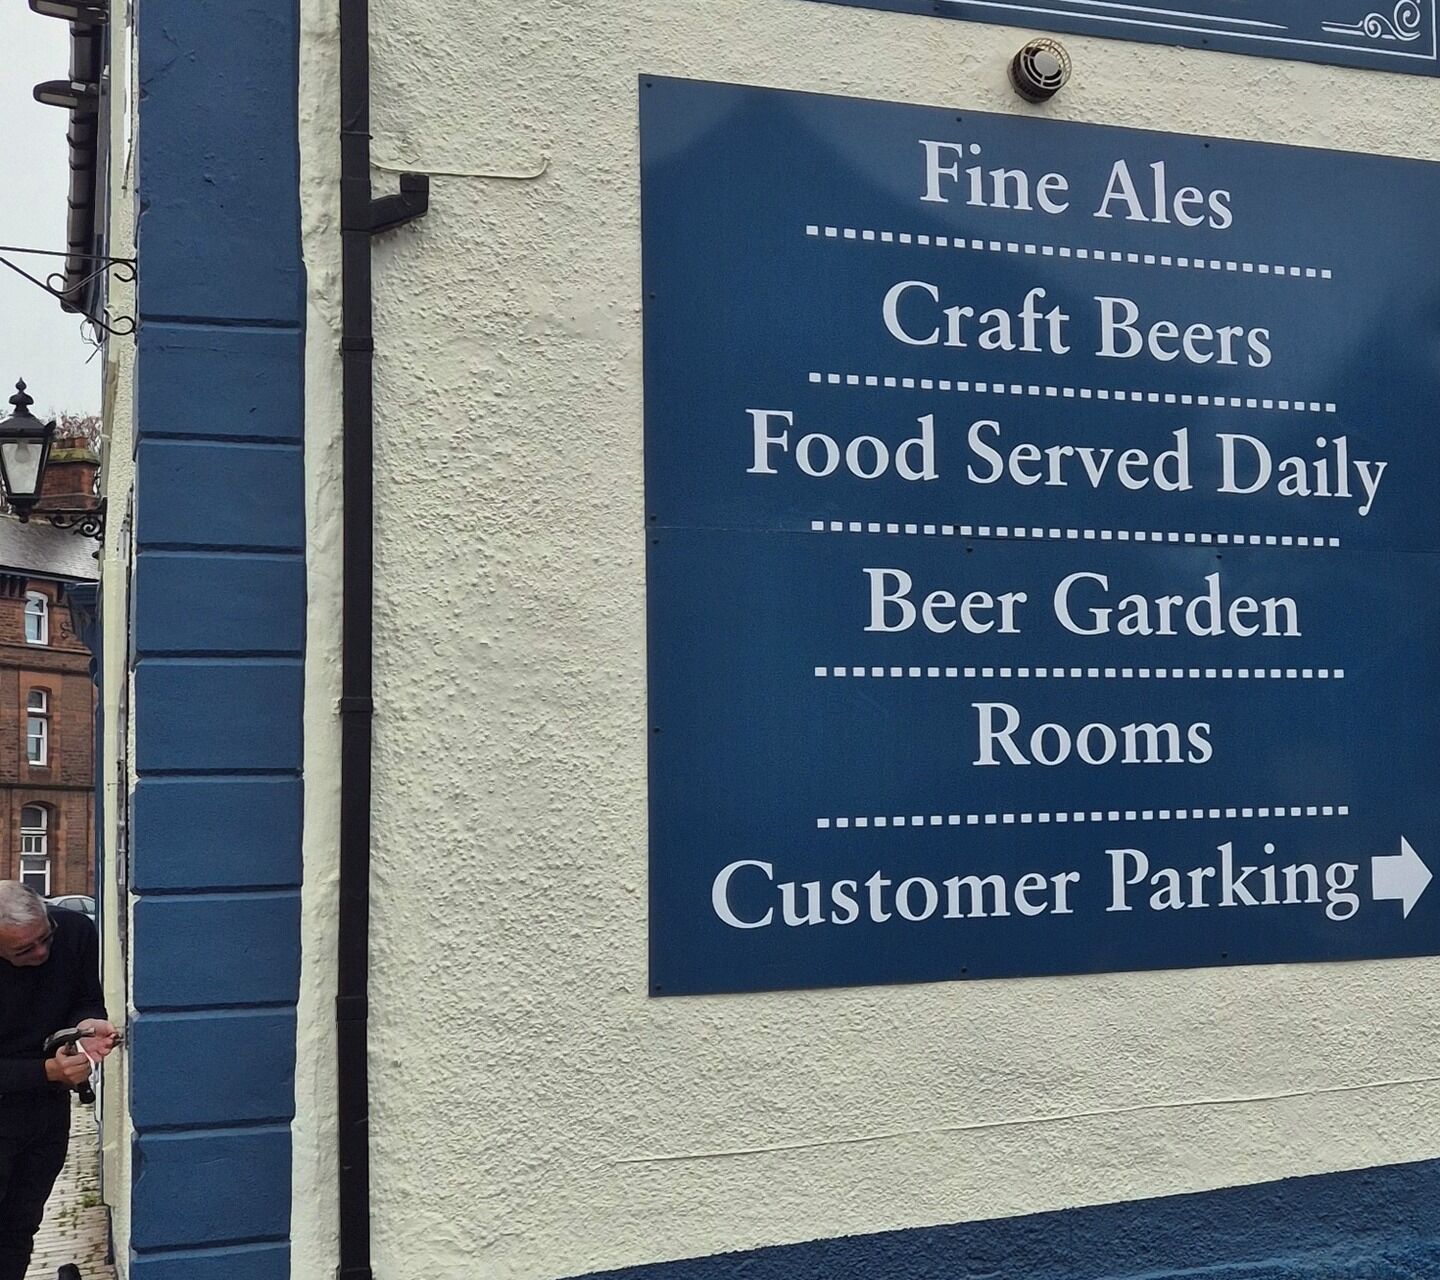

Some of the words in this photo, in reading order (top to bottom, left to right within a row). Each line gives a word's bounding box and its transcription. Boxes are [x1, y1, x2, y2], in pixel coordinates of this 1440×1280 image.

[918, 139, 1070, 214] Fine
[1093, 159, 1233, 230] Ales
[882, 280, 1071, 355] Craft
[1093, 296, 1272, 368] Beers
[745, 408, 939, 481] Food
[967, 420, 1193, 494] Served
[1215, 433, 1388, 516] Daily
[862, 568, 1028, 634] Beer
[1053, 572, 1302, 637] Garden
[971, 702, 1214, 766] Rooms
[711, 859, 1080, 929] Customer
[1105, 841, 1360, 921] Parking
